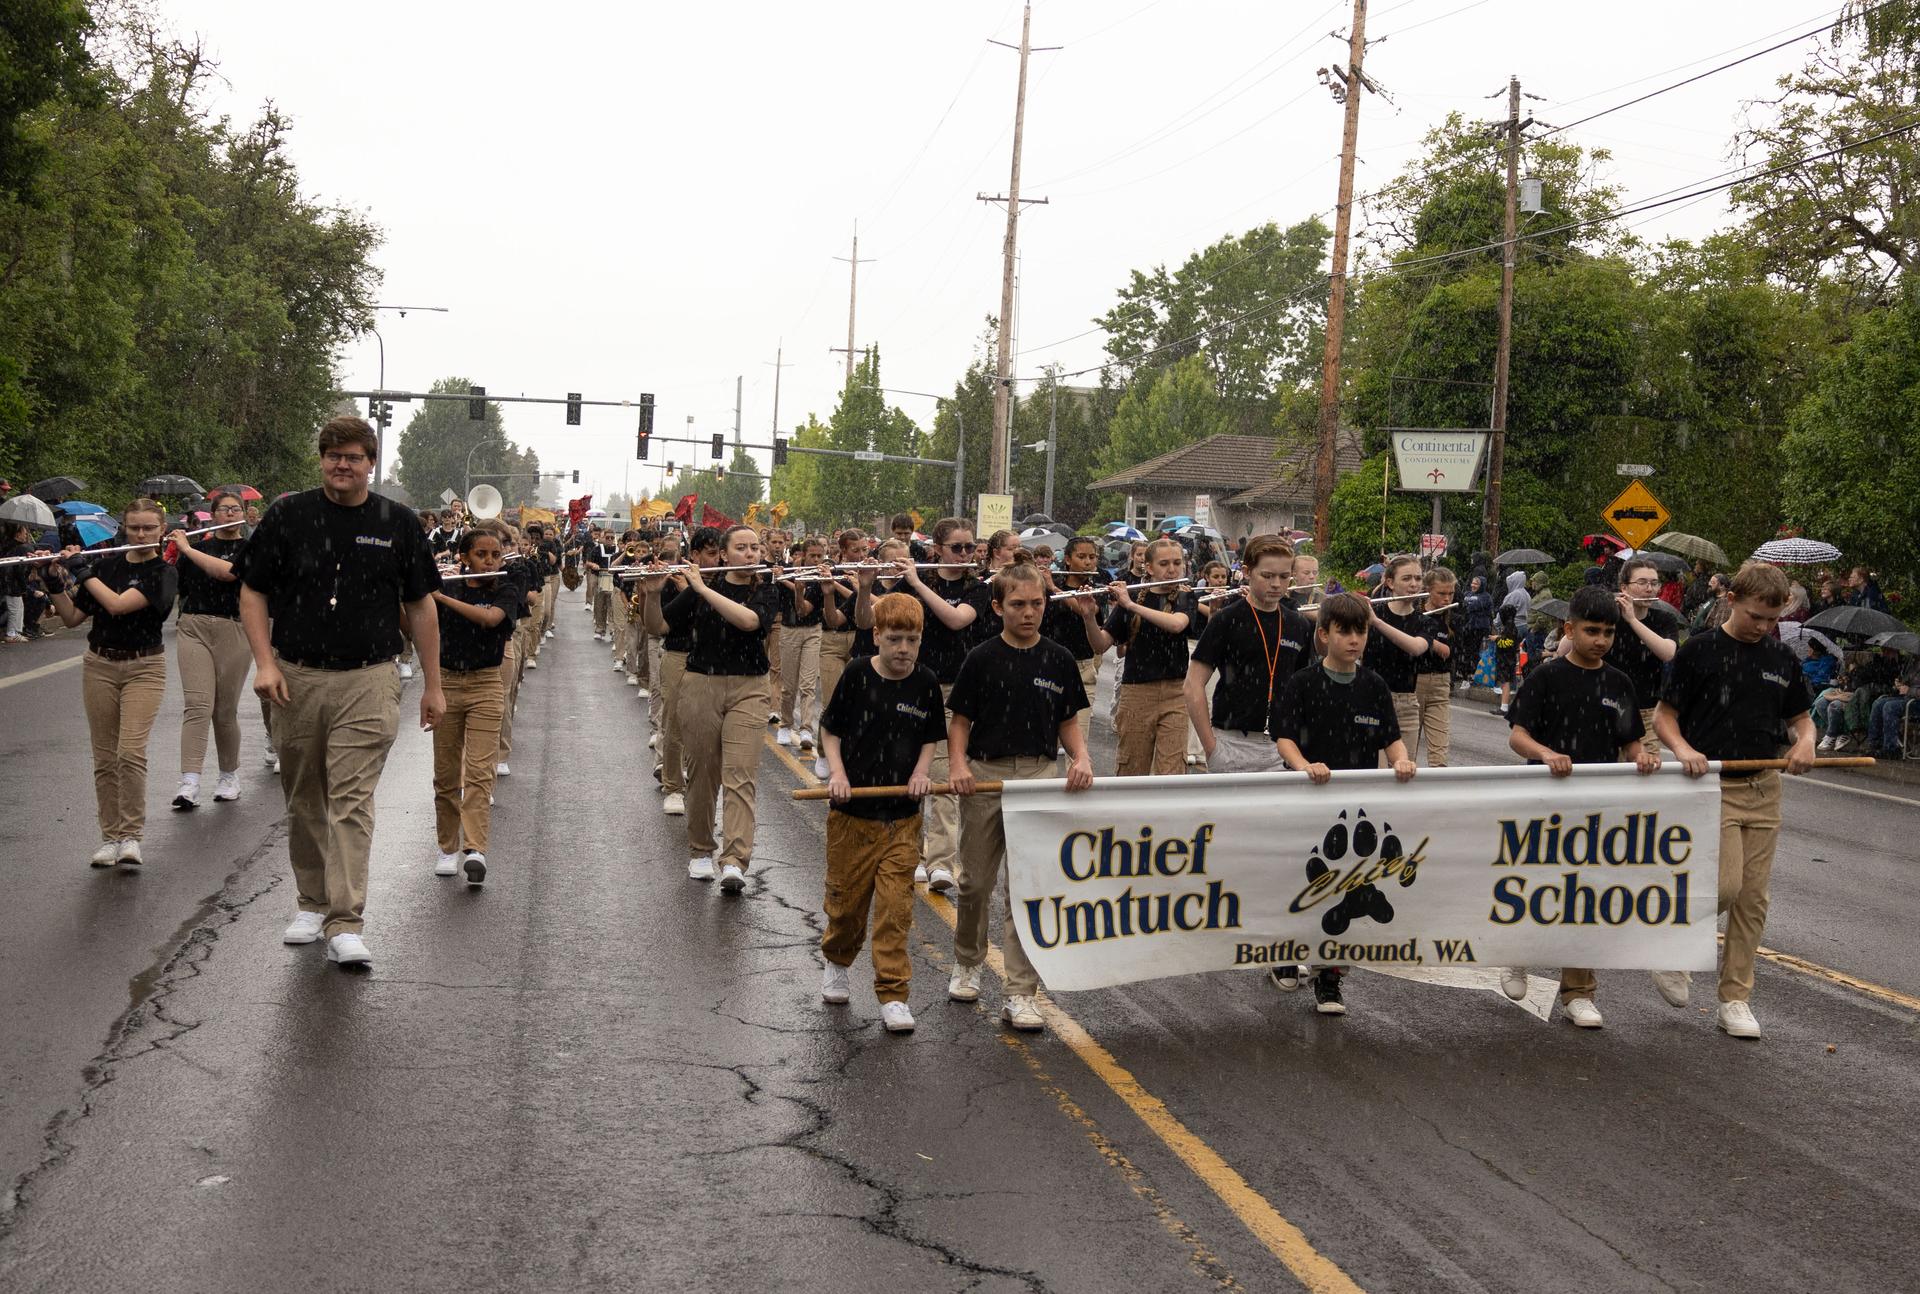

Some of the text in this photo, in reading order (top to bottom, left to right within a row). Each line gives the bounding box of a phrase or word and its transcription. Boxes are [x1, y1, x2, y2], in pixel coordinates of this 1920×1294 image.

[1401, 437, 1475, 453] Continental
[356, 536, 392, 548] Chief Band
[1280, 639, 1295, 648] Chief
[1034, 678, 1051, 688] Chief
[1763, 672, 1779, 682] Chief
[896, 703, 914, 714] Chief
[1354, 715, 1368, 724] Chief
[1491, 811, 1692, 866] Middle
[1060, 823, 1215, 882] Chief
[1289, 836, 1429, 913] Chief
[1488, 870, 1691, 926] School
[1023, 880, 1242, 949] Umtuch
[1235, 938, 1477, 965] Battle Ground, WA
